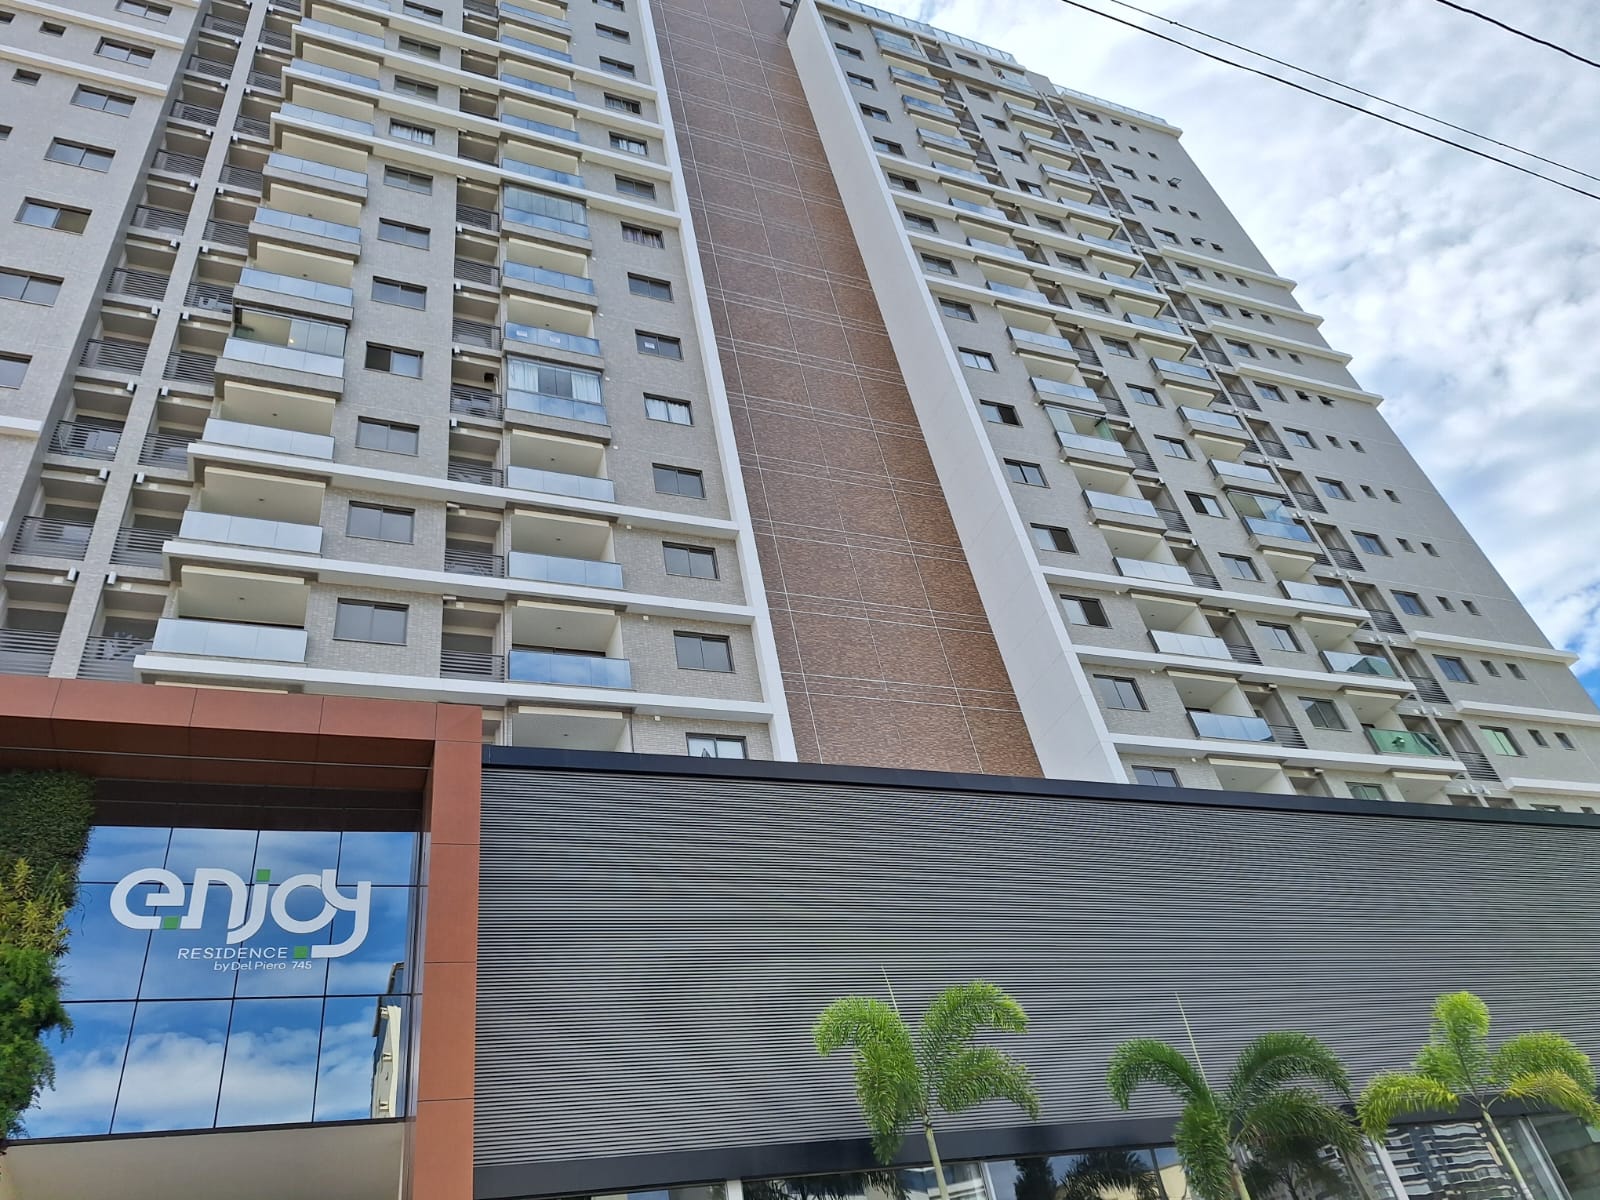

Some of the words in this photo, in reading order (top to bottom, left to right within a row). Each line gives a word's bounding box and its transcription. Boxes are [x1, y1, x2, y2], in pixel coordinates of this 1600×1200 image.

[177, 947, 289, 960] RESIDENCE
[213, 961, 230, 972] by
[231, 961, 252, 970] Del
[254, 961, 286, 970] Piero
[291, 961, 312, 970] 745
